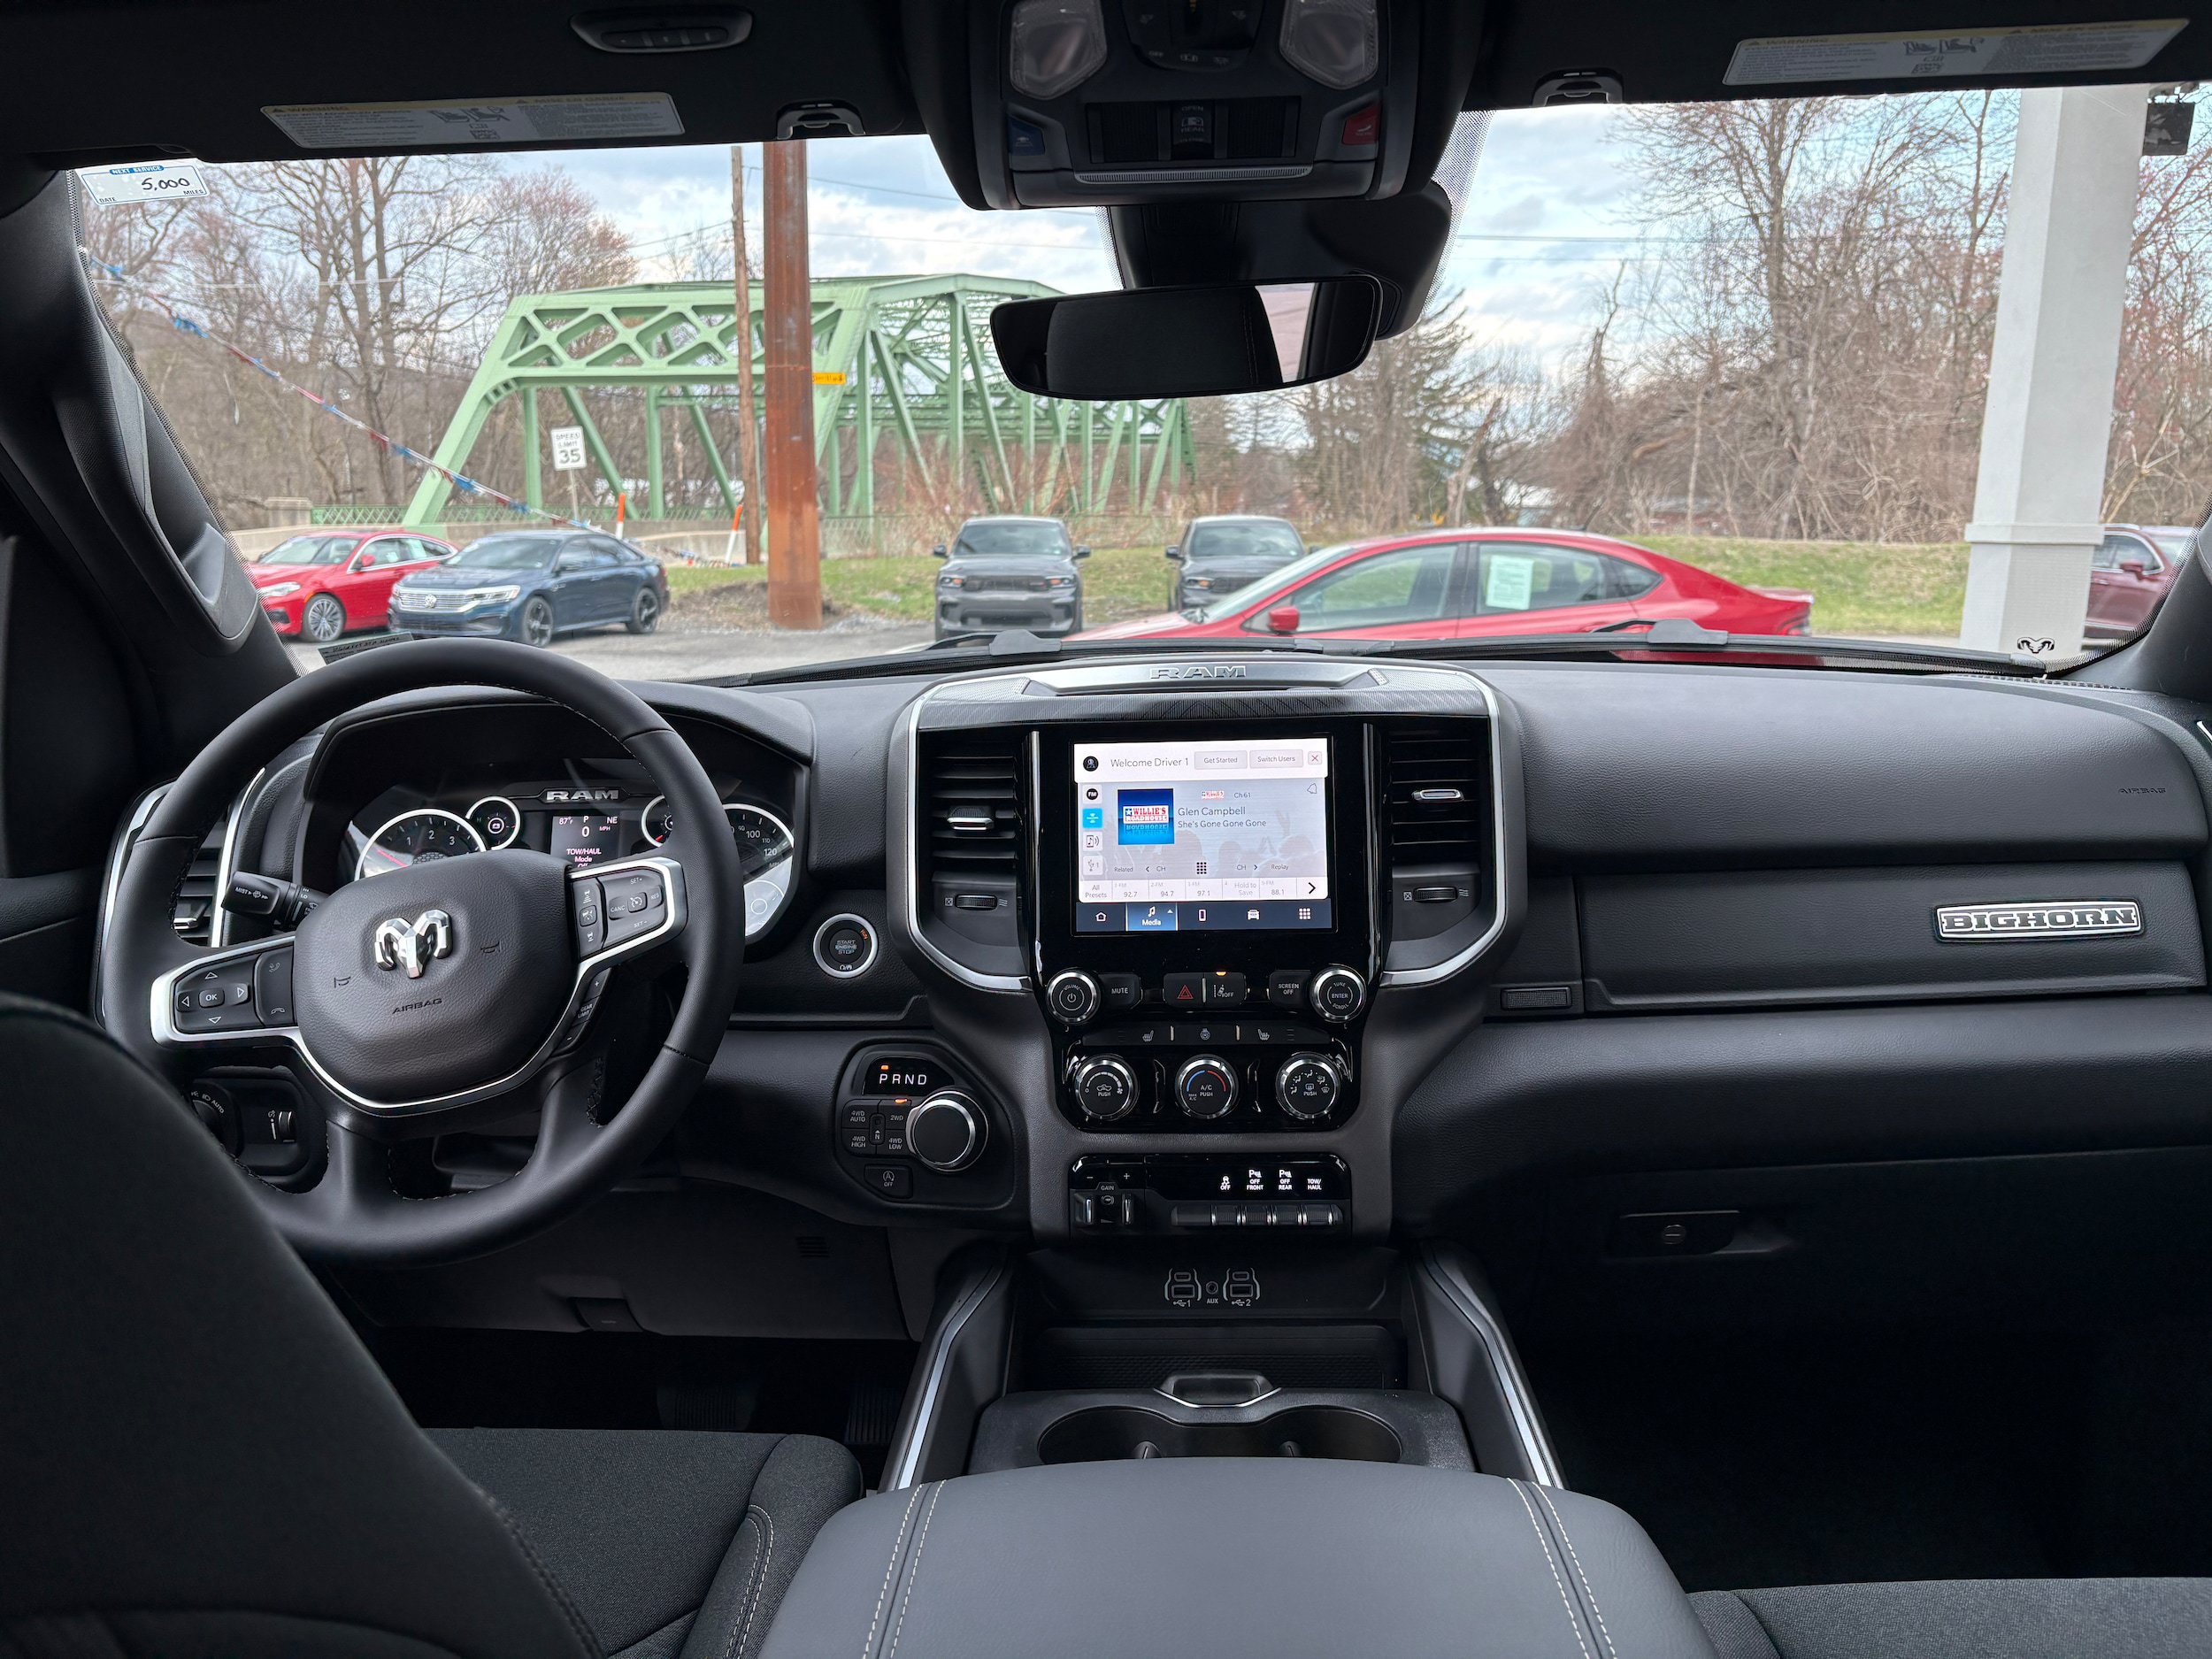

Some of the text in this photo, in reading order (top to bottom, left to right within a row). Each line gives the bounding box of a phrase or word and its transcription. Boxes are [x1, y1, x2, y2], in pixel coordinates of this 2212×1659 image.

[142, 177, 190, 191] 5,000
[558, 449, 581, 464] 35
[1150, 665, 1246, 680] RAM
[1110, 758, 1152, 767] Welcome
[1154, 757, 1182, 766] Driver
[546, 790, 619, 801] RAM
[1178, 806, 1246, 817] Glen Campbell
[428, 830, 434, 840] 2
[581, 826, 590, 837] 0
[746, 830, 761, 839] 100
[407, 836, 411, 846] 1
[449, 836, 455, 846] 3
[764, 848, 778, 856] 120
[1942, 909, 2135, 930] BIGHORN
[205, 993, 218, 1002] OK
[392, 998, 442, 1014] AIRBAG
[211, 1099, 225, 1114] AUTO
